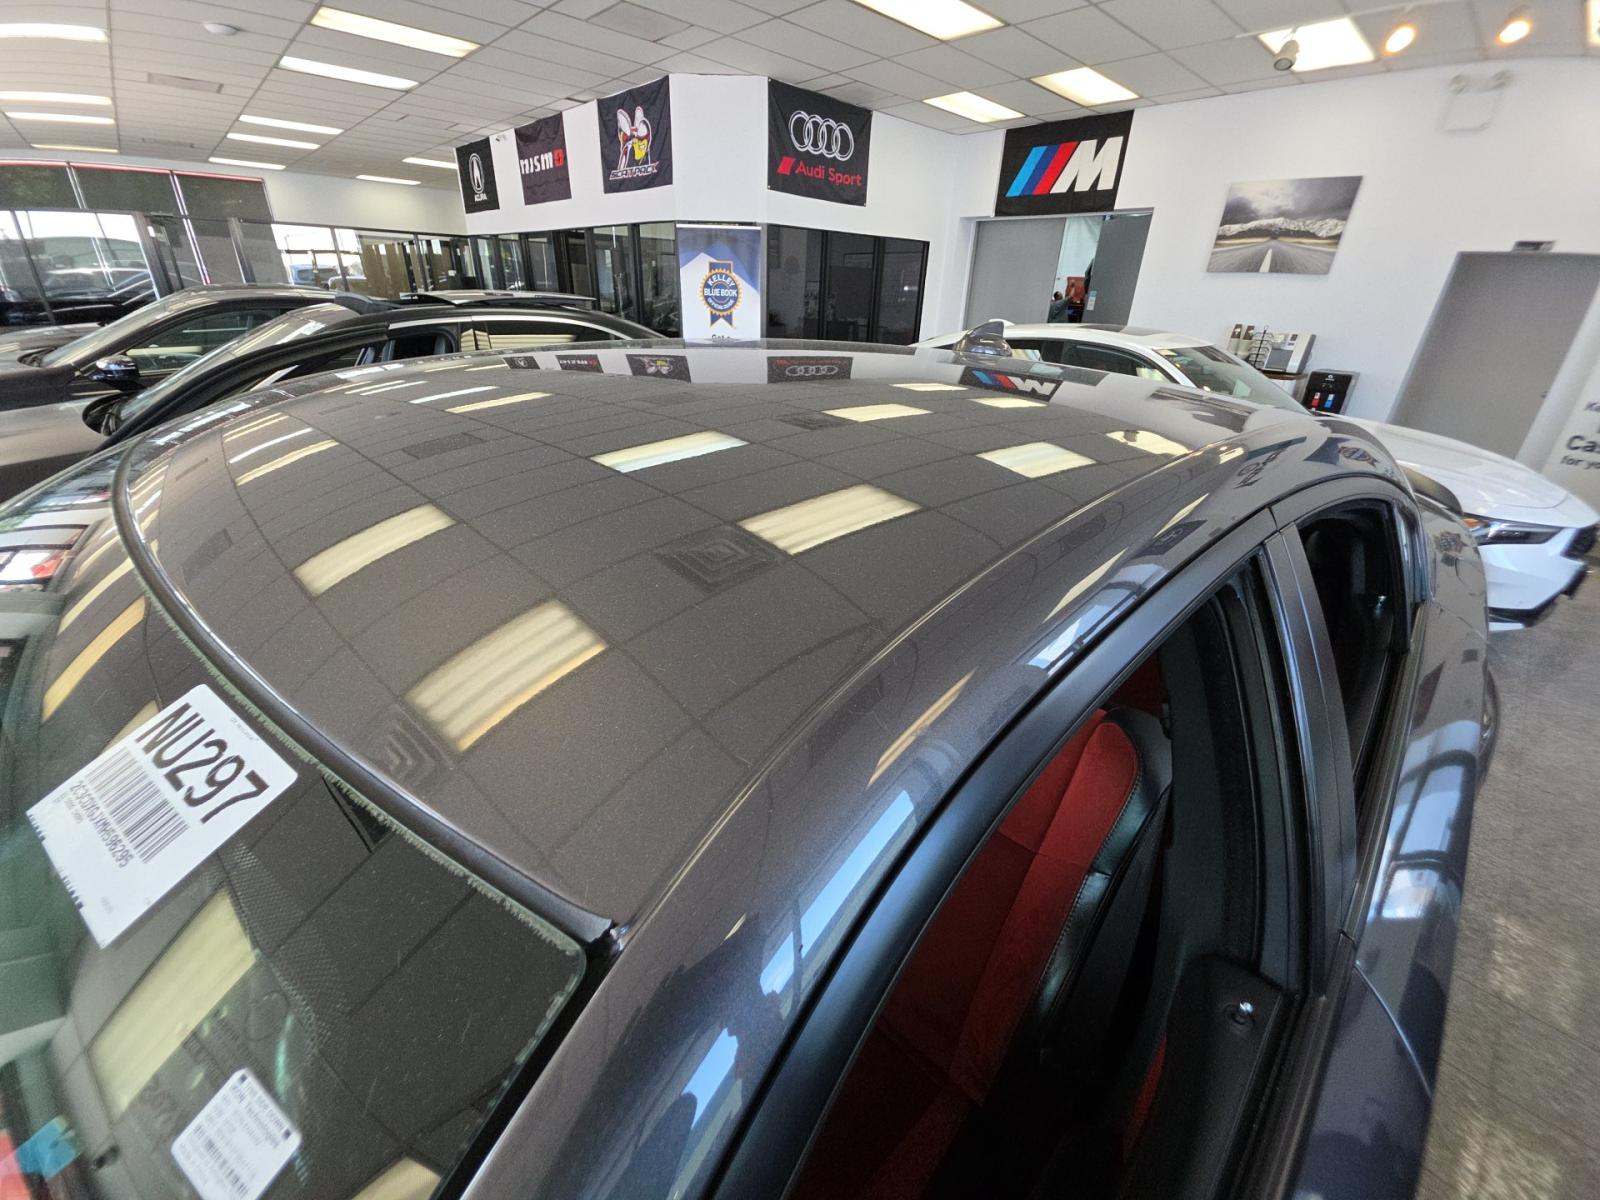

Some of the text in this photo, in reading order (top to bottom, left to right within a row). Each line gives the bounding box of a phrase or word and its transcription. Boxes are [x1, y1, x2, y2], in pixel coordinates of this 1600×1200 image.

[795, 160, 862, 186] Audi Sport
[706, 273, 736, 287] KELLEY
[703, 288, 738, 297] BLUE BOOK
[1567, 435, 1600, 454] Ca
[1560, 455, 1584, 466] for
[135, 702, 270, 825] NU297
